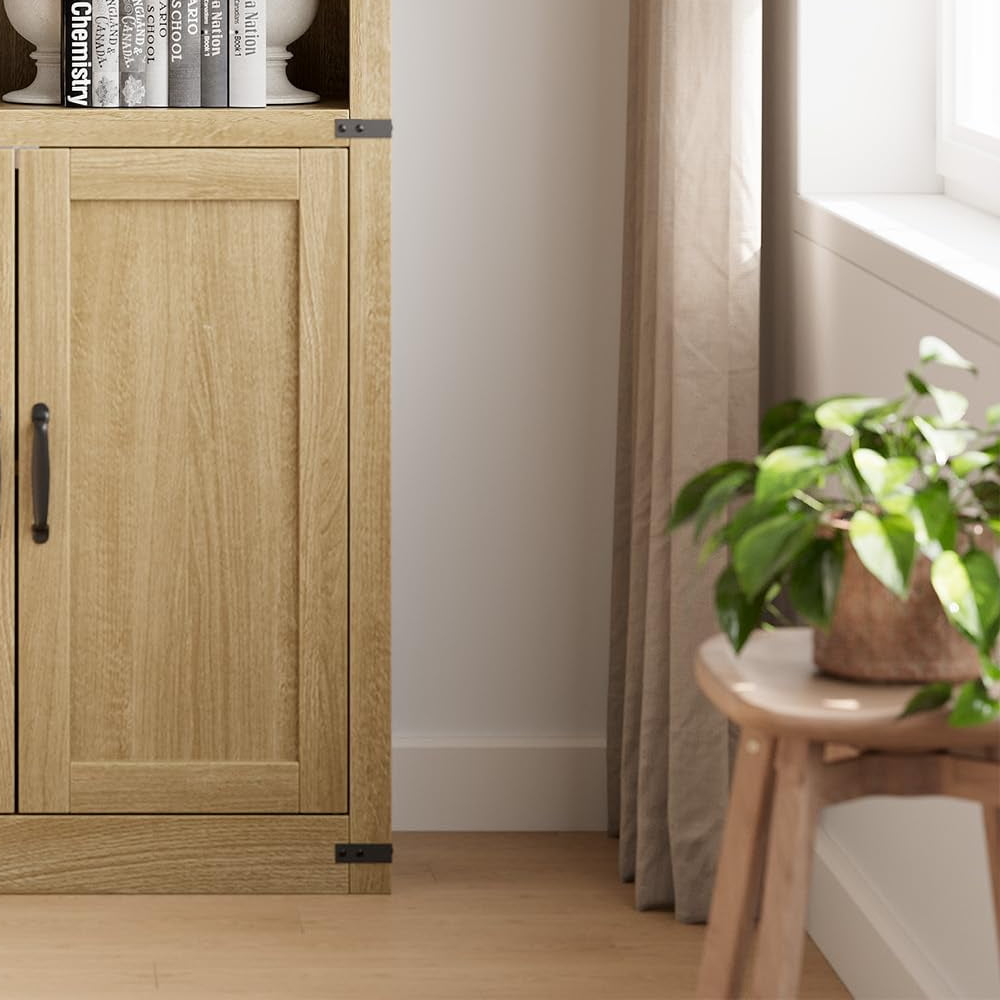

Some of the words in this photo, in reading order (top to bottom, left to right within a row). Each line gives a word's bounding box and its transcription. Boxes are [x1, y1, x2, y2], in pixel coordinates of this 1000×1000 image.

[211, 1, 220, 9] a
[244, 1, 256, 9] a
[133, 46, 142, 55] &
[146, 4, 155, 64] SCHOOL
[171, 0, 182, 62] SCHOOL
[211, 11, 223, 56] Nation
[244, 11, 259, 56] Nation
[67, 2, 92, 106] Chemistry
